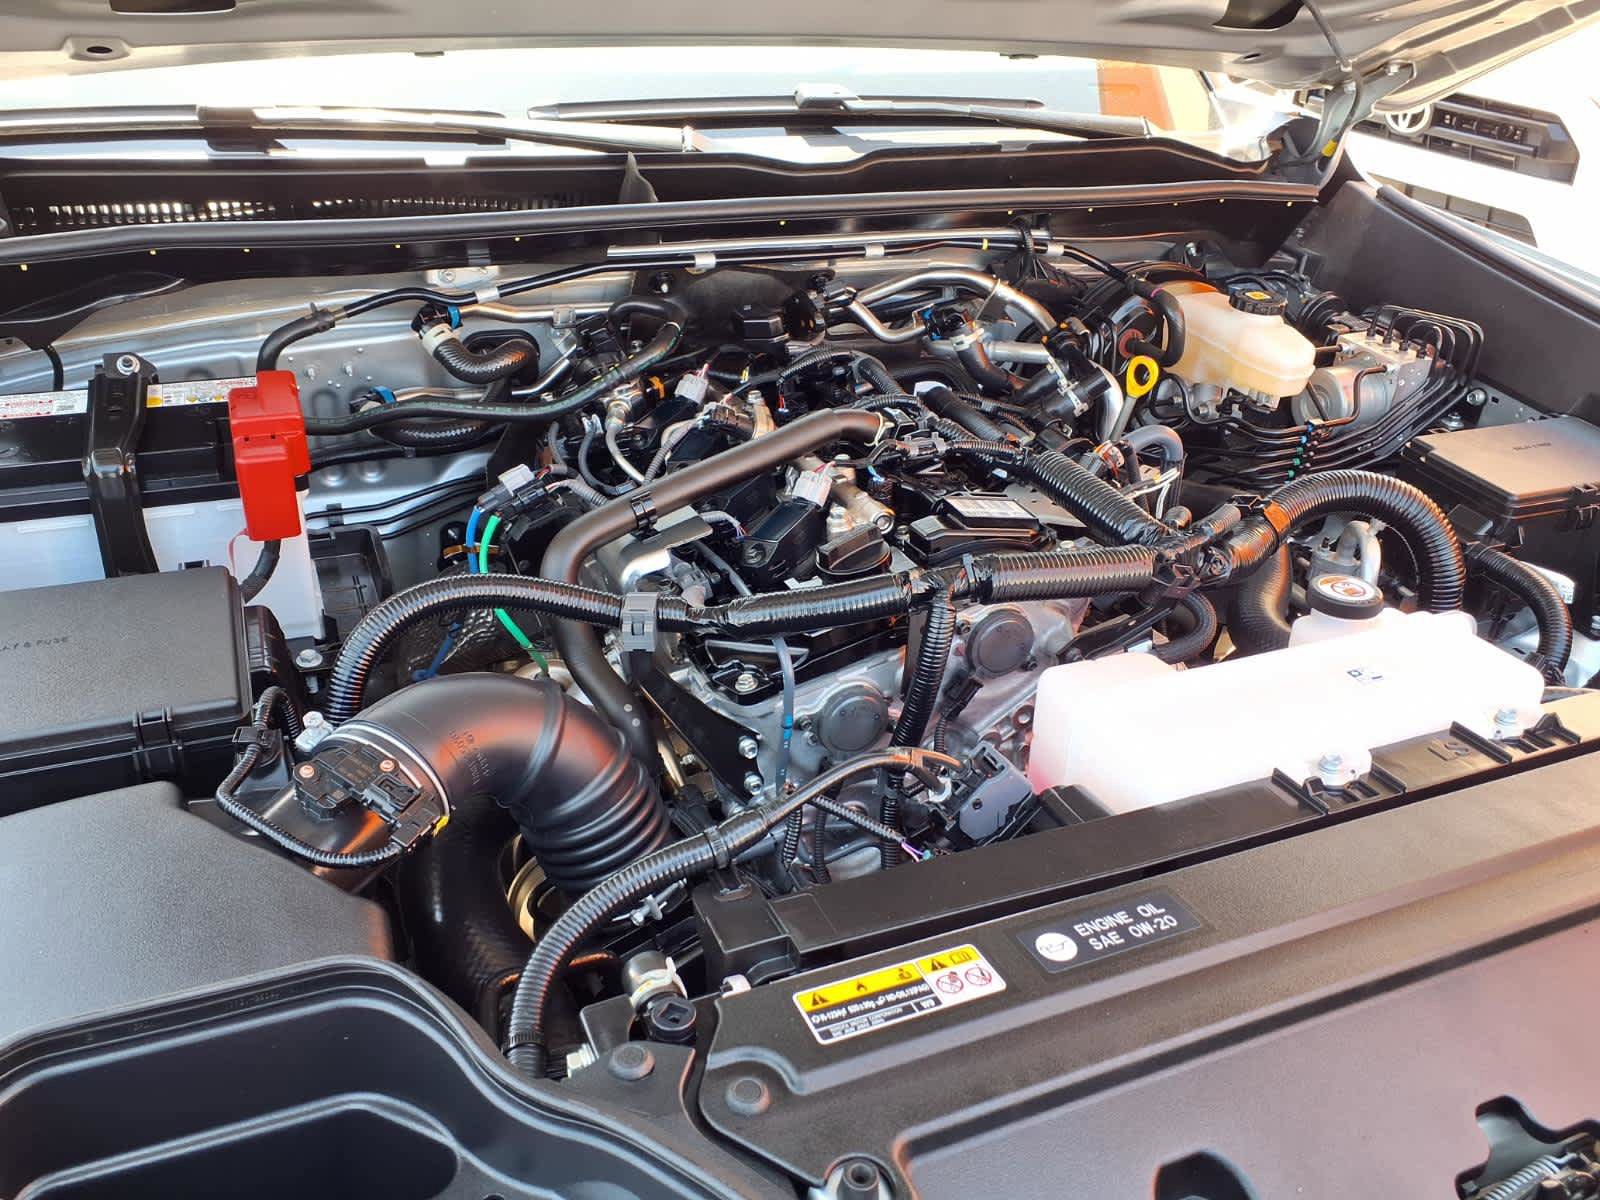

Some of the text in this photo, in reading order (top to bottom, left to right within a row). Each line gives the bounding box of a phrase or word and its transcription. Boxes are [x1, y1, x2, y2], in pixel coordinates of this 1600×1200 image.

[1073, 903, 1166, 937] ENGINE OIL
[1088, 915, 1178, 950] SAE 0W-20
